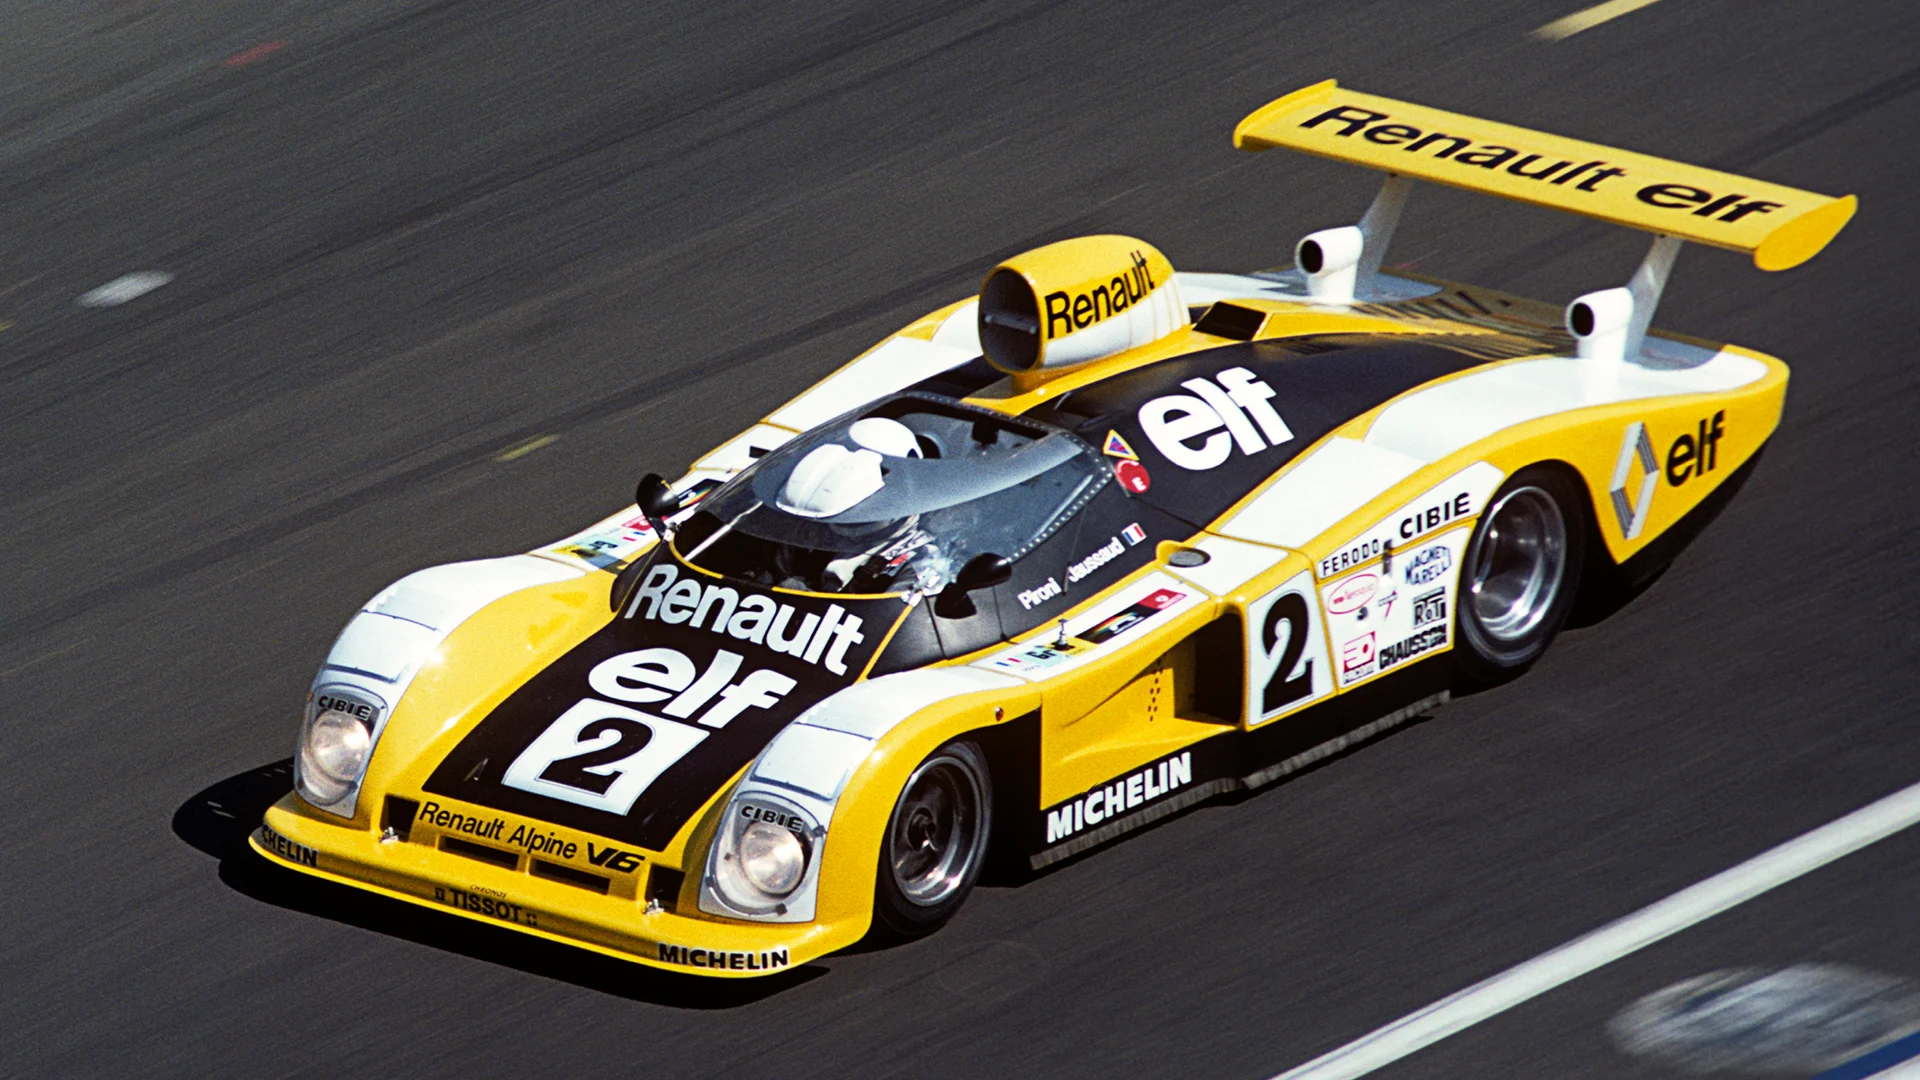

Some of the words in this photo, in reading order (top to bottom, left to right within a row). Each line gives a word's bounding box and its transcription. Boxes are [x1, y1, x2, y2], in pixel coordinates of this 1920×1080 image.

[1300, 105, 1627, 191] Renault
[1637, 184, 1787, 223] elf
[1045, 250, 1155, 339] Renault
[1138, 367, 1294, 470] elf
[1666, 409, 1726, 487] elf
[1399, 492, 1471, 539] CIBIE
[1017, 577, 1062, 610] Pironi
[1068, 536, 1125, 583] Jaussaud
[1322, 538, 1379, 577] FERODO
[624, 564, 864, 676] Renault
[1262, 589, 1314, 716] 2
[319, 695, 371, 720] CIBIE
[588, 648, 797, 728] elf
[536, 717, 654, 797] 2
[742, 806, 803, 831] CIBIE
[1047, 752, 1191, 843] MICHELIN
[418, 802, 504, 841] Renault
[506, 824, 578, 860] Alpine
[585, 842, 645, 874] V6
[450, 888, 523, 921] TISSOT
[659, 943, 789, 970] MICHELIN
